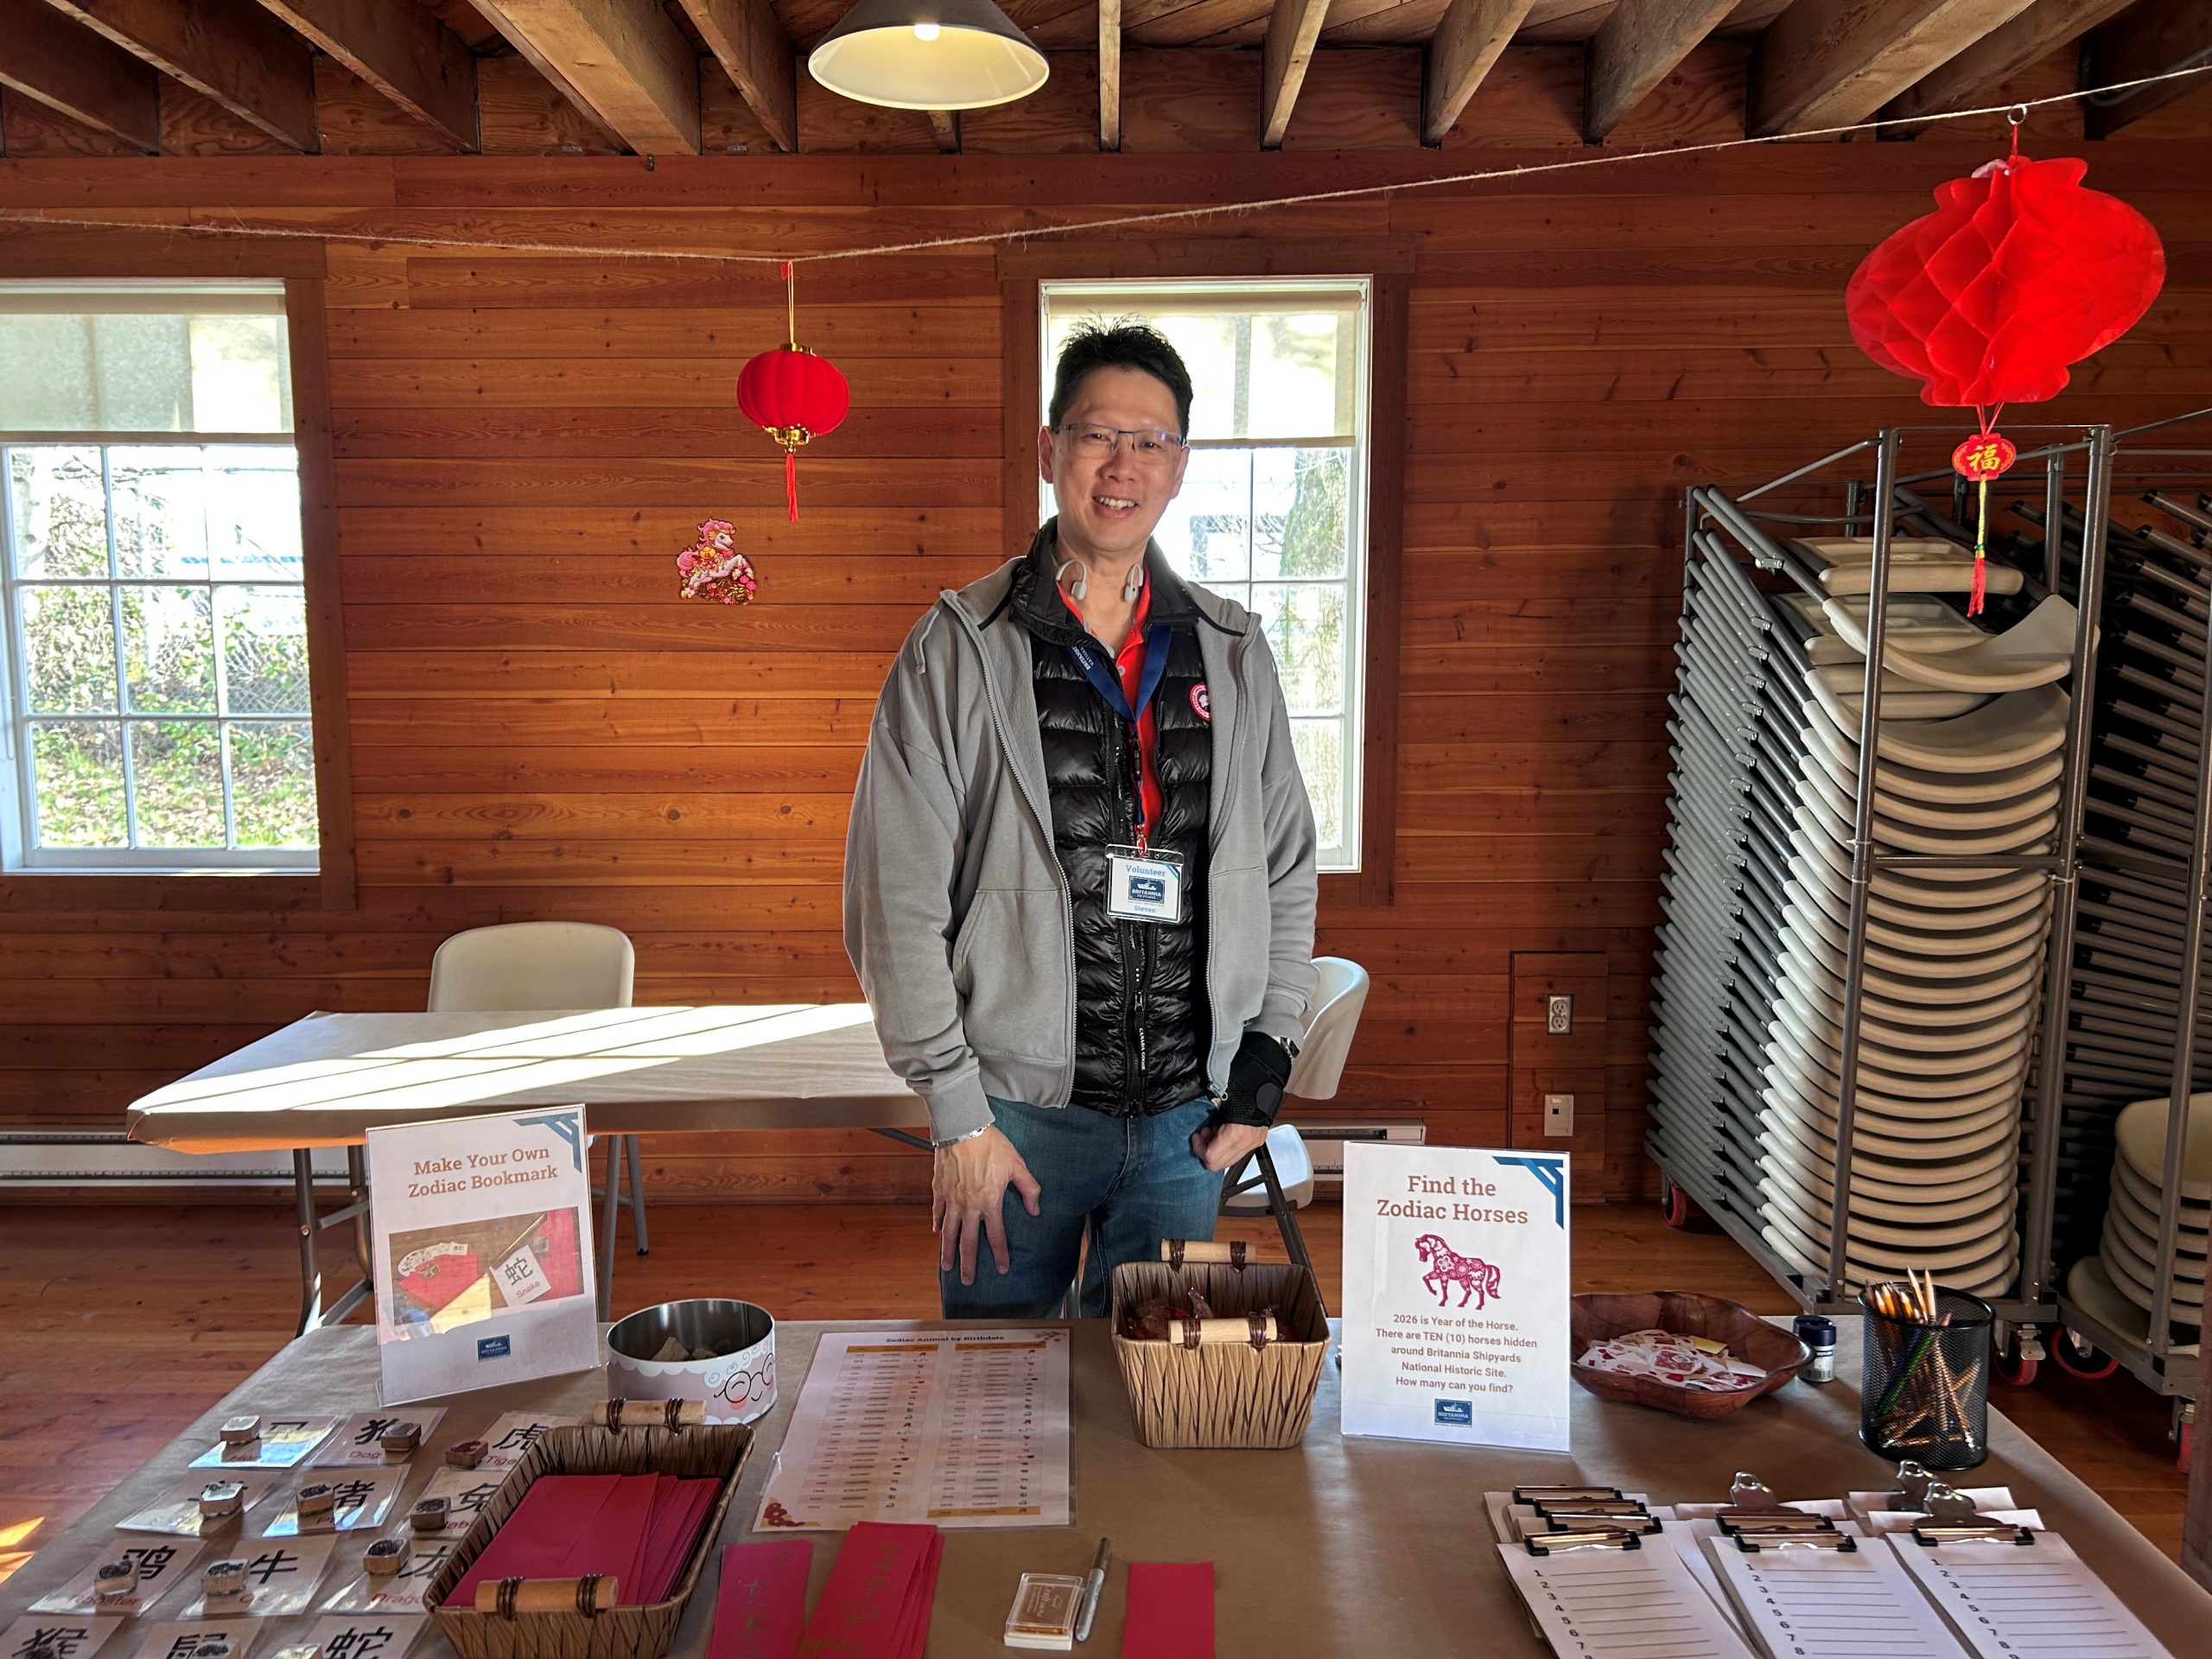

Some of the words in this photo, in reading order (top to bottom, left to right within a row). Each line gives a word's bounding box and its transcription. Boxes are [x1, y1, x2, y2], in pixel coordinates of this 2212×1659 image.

[1967, 444, 2000, 471] 福
[1072, 646, 1091, 671] BRITANNI
[1126, 865, 1166, 877] Volunteer
[414, 1158, 462, 1176] Make
[467, 1154, 507, 1168] Your
[512, 1147, 550, 1162] Own
[408, 1179, 466, 1198] Zodiac
[471, 1165, 558, 1190] Bookmark
[1408, 1175, 1456, 1194] Find
[1461, 1178, 1497, 1196] the
[1376, 1199, 1446, 1219] Zodiac
[1452, 1204, 1529, 1224] Horses
[505, 1257, 532, 1287] 蛇
[516, 1281, 540, 1298] Snake
[1393, 1313, 1418, 1324] 2026
[1421, 1316, 1429, 1325] is
[1431, 1317, 1452, 1326] Year
[1455, 1318, 1465, 1327] of
[1468, 1319, 1484, 1329] the
[1486, 1320, 1518, 1331] Horse.
[1376, 1328, 1403, 1338] There
[1423, 1332, 1443, 1341] TEN
[1446, 1332, 1465, 1345] (10)
[1468, 1334, 1501, 1345] horses
[1503, 1337, 1537, 1348] hidden
[1390, 1346, 1424, 1356] around
[1427, 1348, 1470, 1359] Britannia
[1472, 1351, 1522, 1363] Shipyards
[1402, 1362, 1441, 1373] National
[1444, 1364, 1482, 1376] Historic
[1484, 1368, 1507, 1377] Site.
[1395, 1376, 1417, 1386] How
[1420, 1380, 1446, 1390] many
[1469, 1382, 1486, 1393] you
[1489, 1382, 1513, 1393] find?
[349, 1451, 380, 1460] Dog
[486, 1455, 518, 1467] Tige
[250, 1549, 298, 1585] 牛
[372, 1592, 423, 1607] Drago
[1569, 1629, 1579, 1637] 6
[1795, 1647, 1805, 1656] 8
[1999, 1641, 2011, 1649] 8
